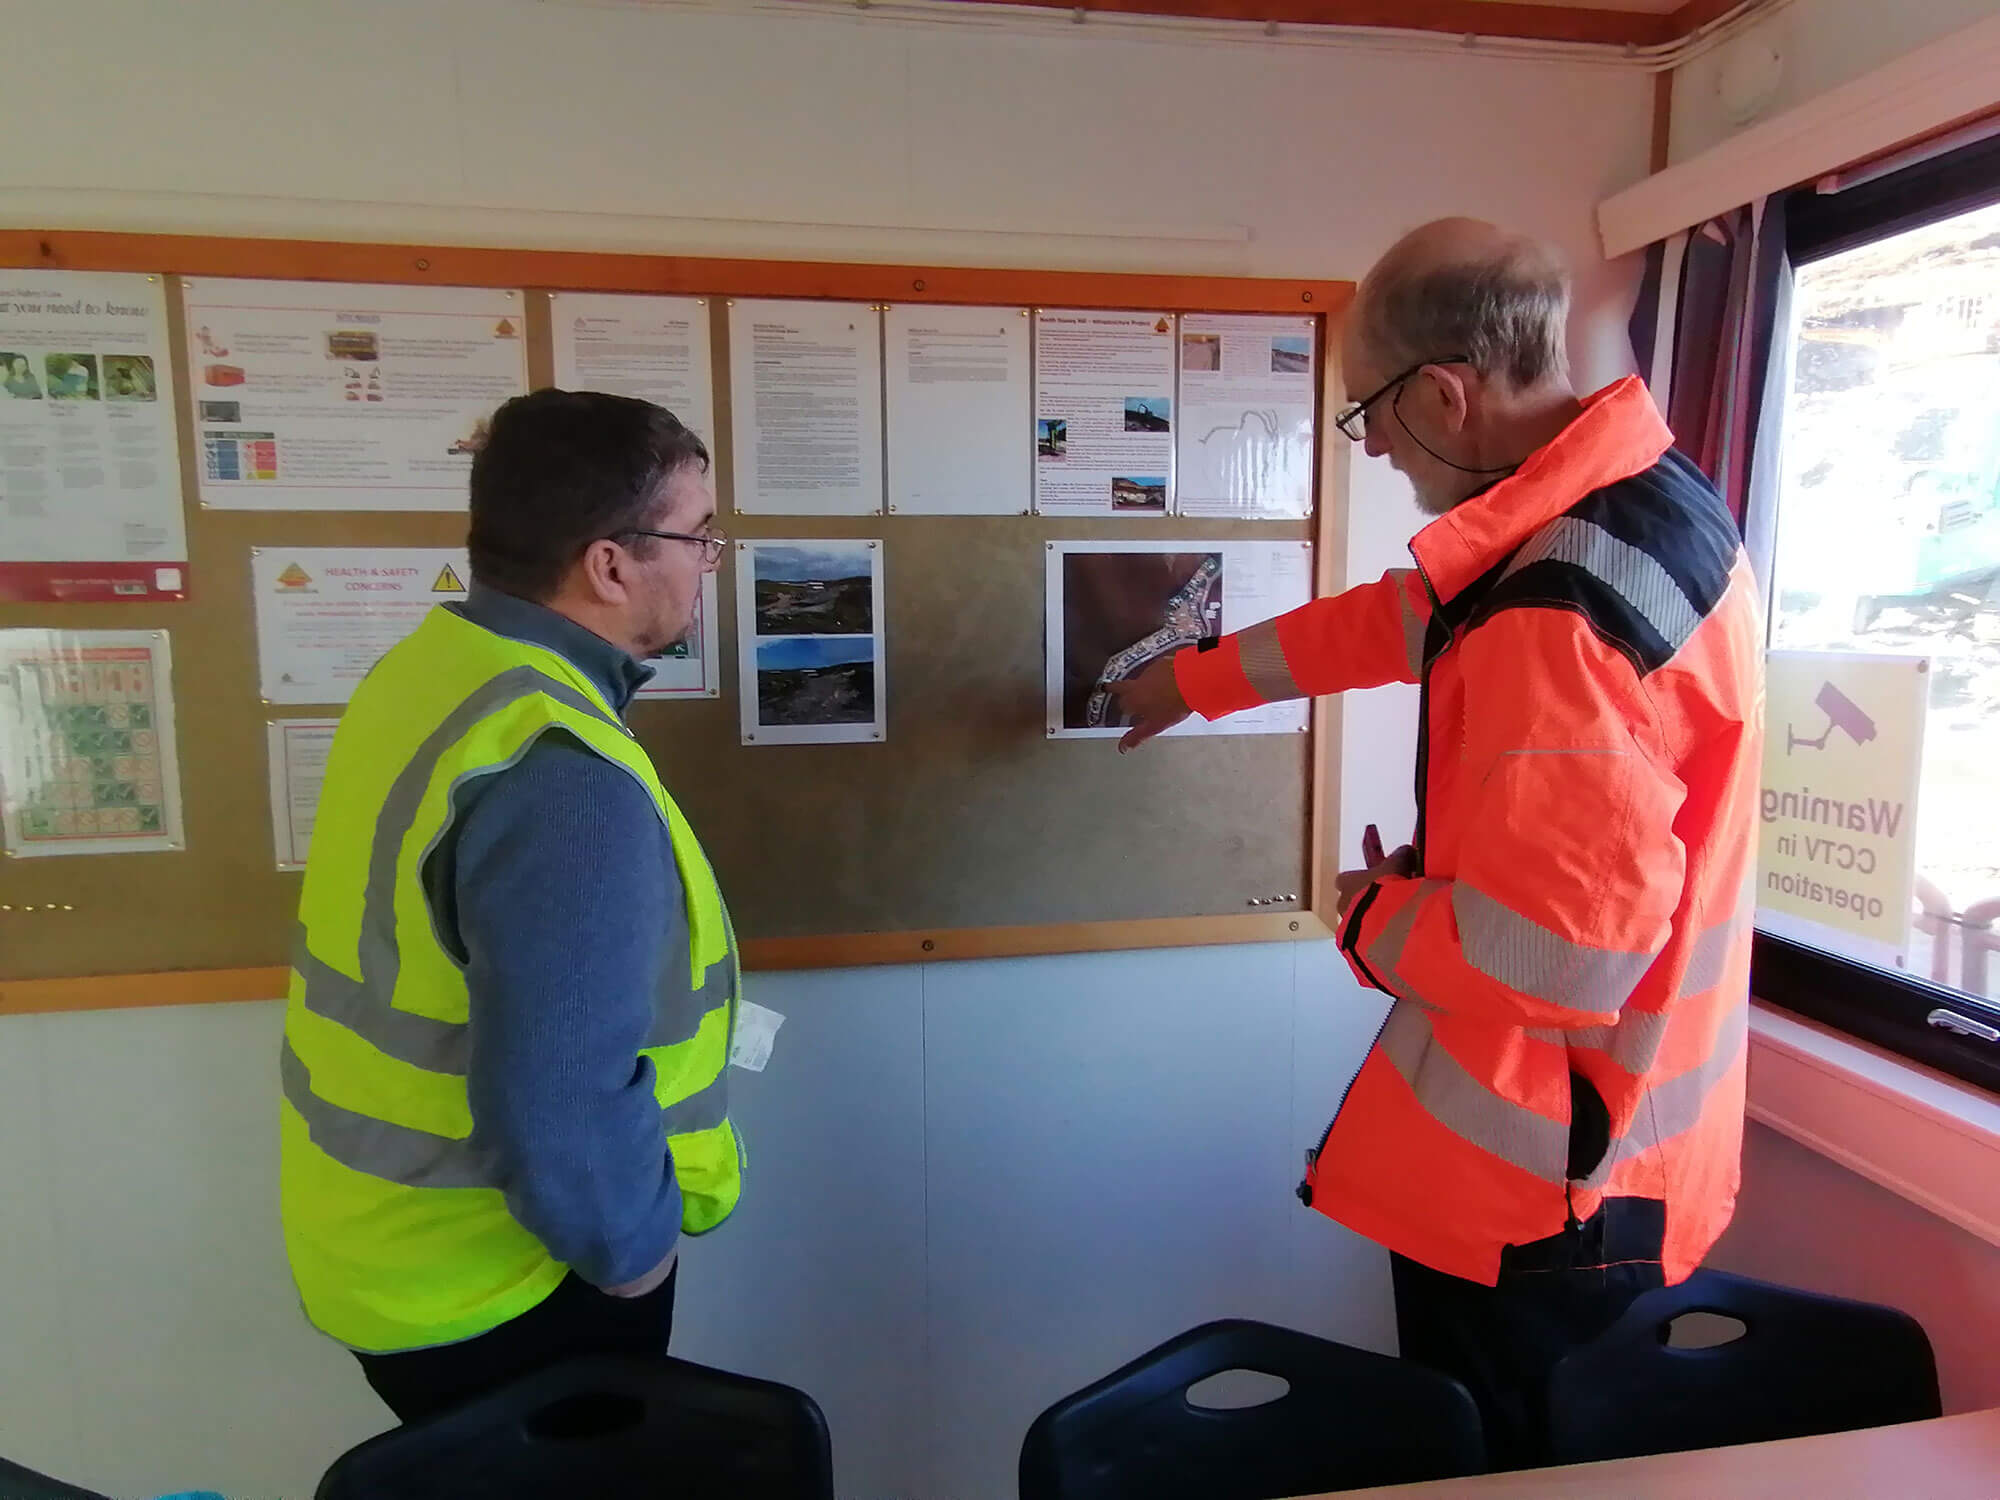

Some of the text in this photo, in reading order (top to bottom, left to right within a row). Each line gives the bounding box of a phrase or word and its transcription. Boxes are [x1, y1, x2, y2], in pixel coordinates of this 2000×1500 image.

[14, 302, 42, 317] you
[47, 300, 81, 315] need
[85, 302, 101, 315] to
[106, 301, 149, 317] know
[325, 567, 419, 577] HEALTH & SAFETY
[344, 582, 403, 592] CONCERNS
